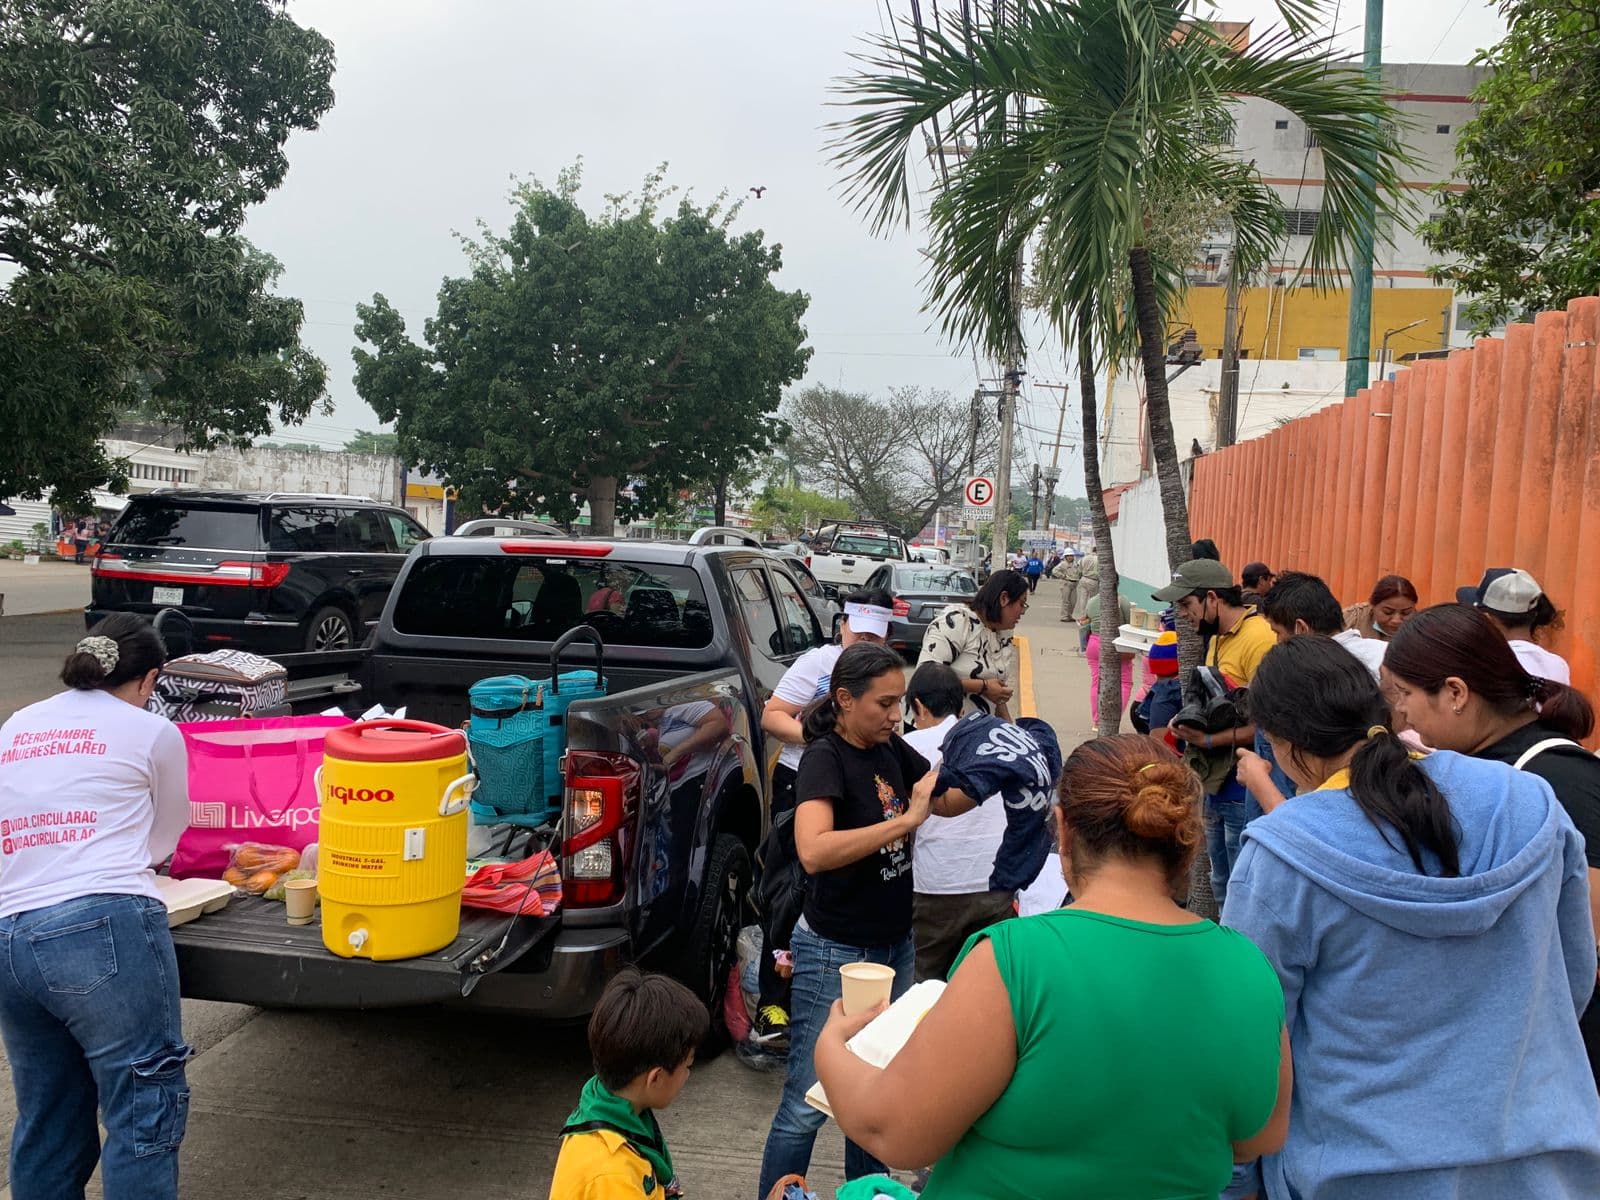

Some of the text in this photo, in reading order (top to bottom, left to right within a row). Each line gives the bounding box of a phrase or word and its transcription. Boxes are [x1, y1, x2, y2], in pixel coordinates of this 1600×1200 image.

[974, 483, 985, 500] E
[330, 785, 395, 805] IGLOO
[231, 805, 320, 832] Liverpo
